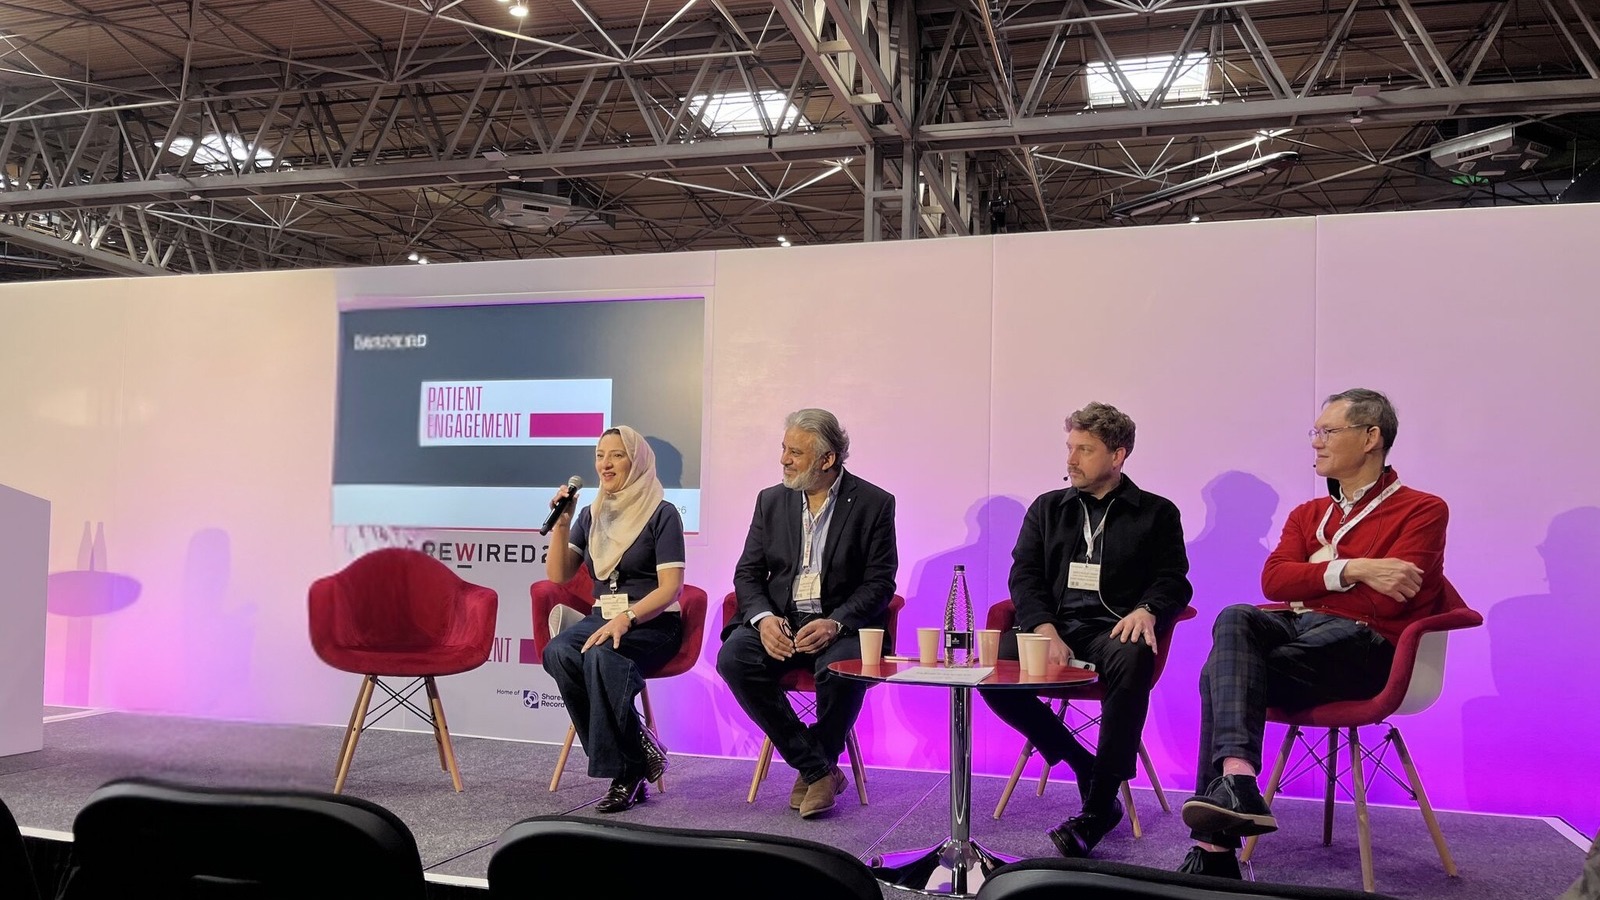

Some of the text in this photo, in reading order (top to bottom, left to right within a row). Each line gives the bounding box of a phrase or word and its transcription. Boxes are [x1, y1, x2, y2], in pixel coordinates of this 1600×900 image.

[427, 386, 483, 411] PATIENT
[427, 413, 521, 438] ENGAGEMENT
[422, 541, 536, 564] REWIRED
[541, 693, 563, 701] Share
